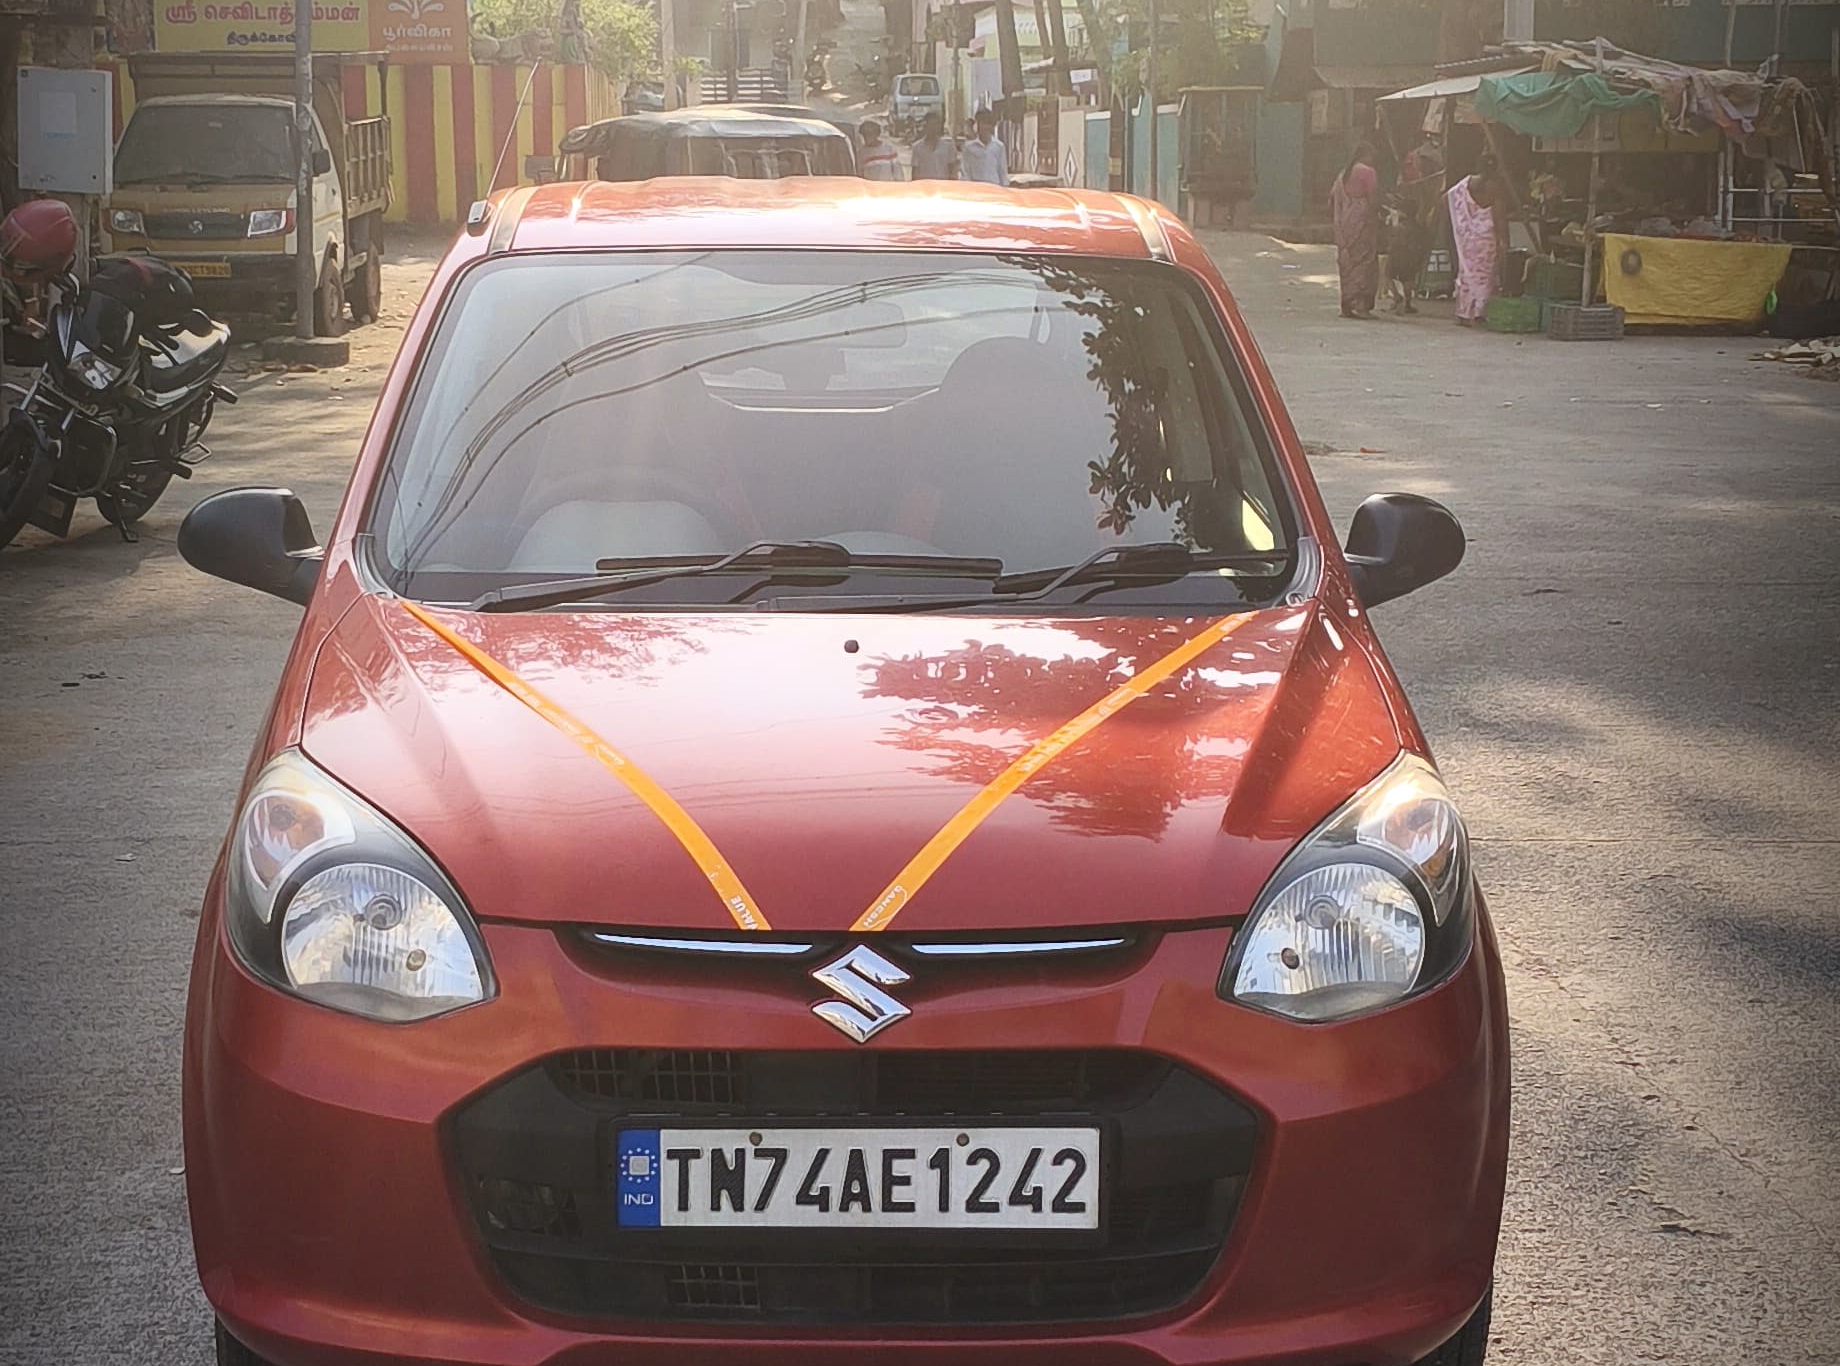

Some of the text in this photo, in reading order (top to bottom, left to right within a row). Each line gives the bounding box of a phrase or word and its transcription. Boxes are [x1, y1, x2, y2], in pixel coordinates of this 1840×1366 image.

[204, 1, 360, 26] செவிடாத்ம்மன்
[666, 1146, 1087, 1214] TN74AE1242
[624, 1193, 654, 1206] IND
